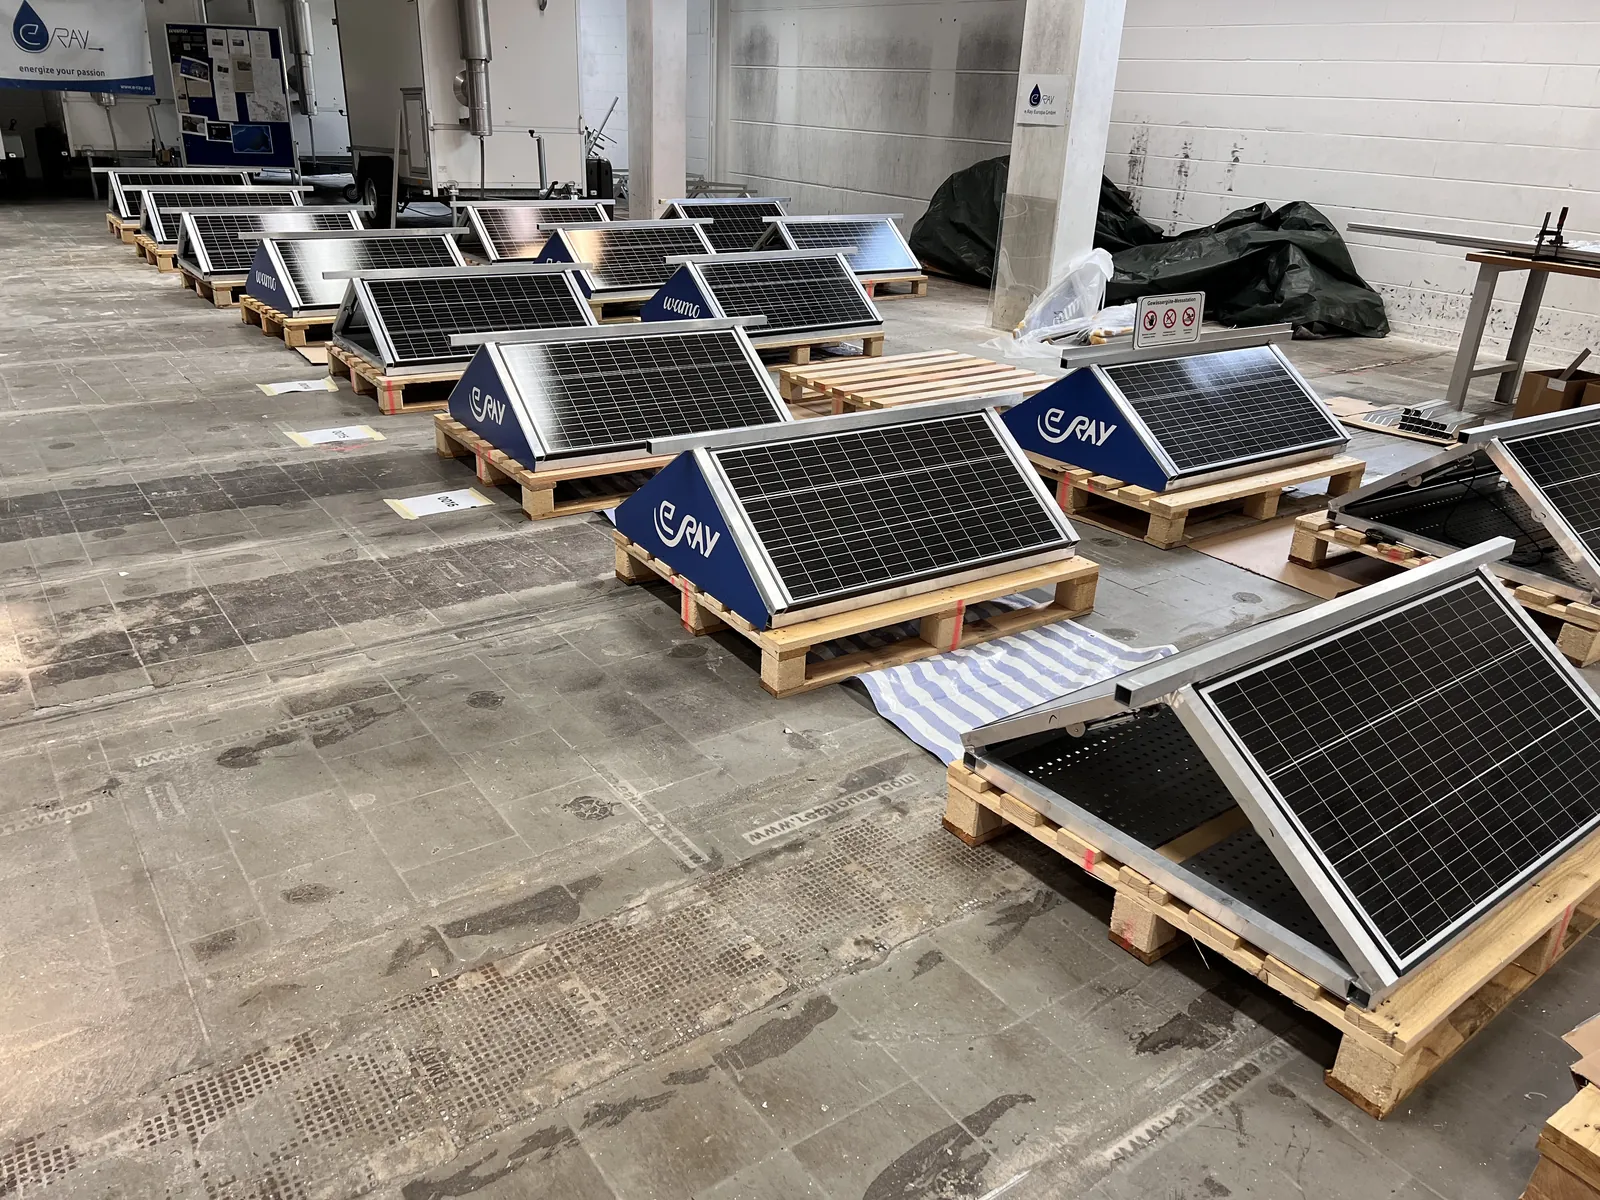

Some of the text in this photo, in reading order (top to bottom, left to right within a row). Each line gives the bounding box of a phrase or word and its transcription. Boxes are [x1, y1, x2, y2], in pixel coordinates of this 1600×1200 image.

[19, 65, 106, 78] energize your passion
[663, 296, 701, 318] wamo
